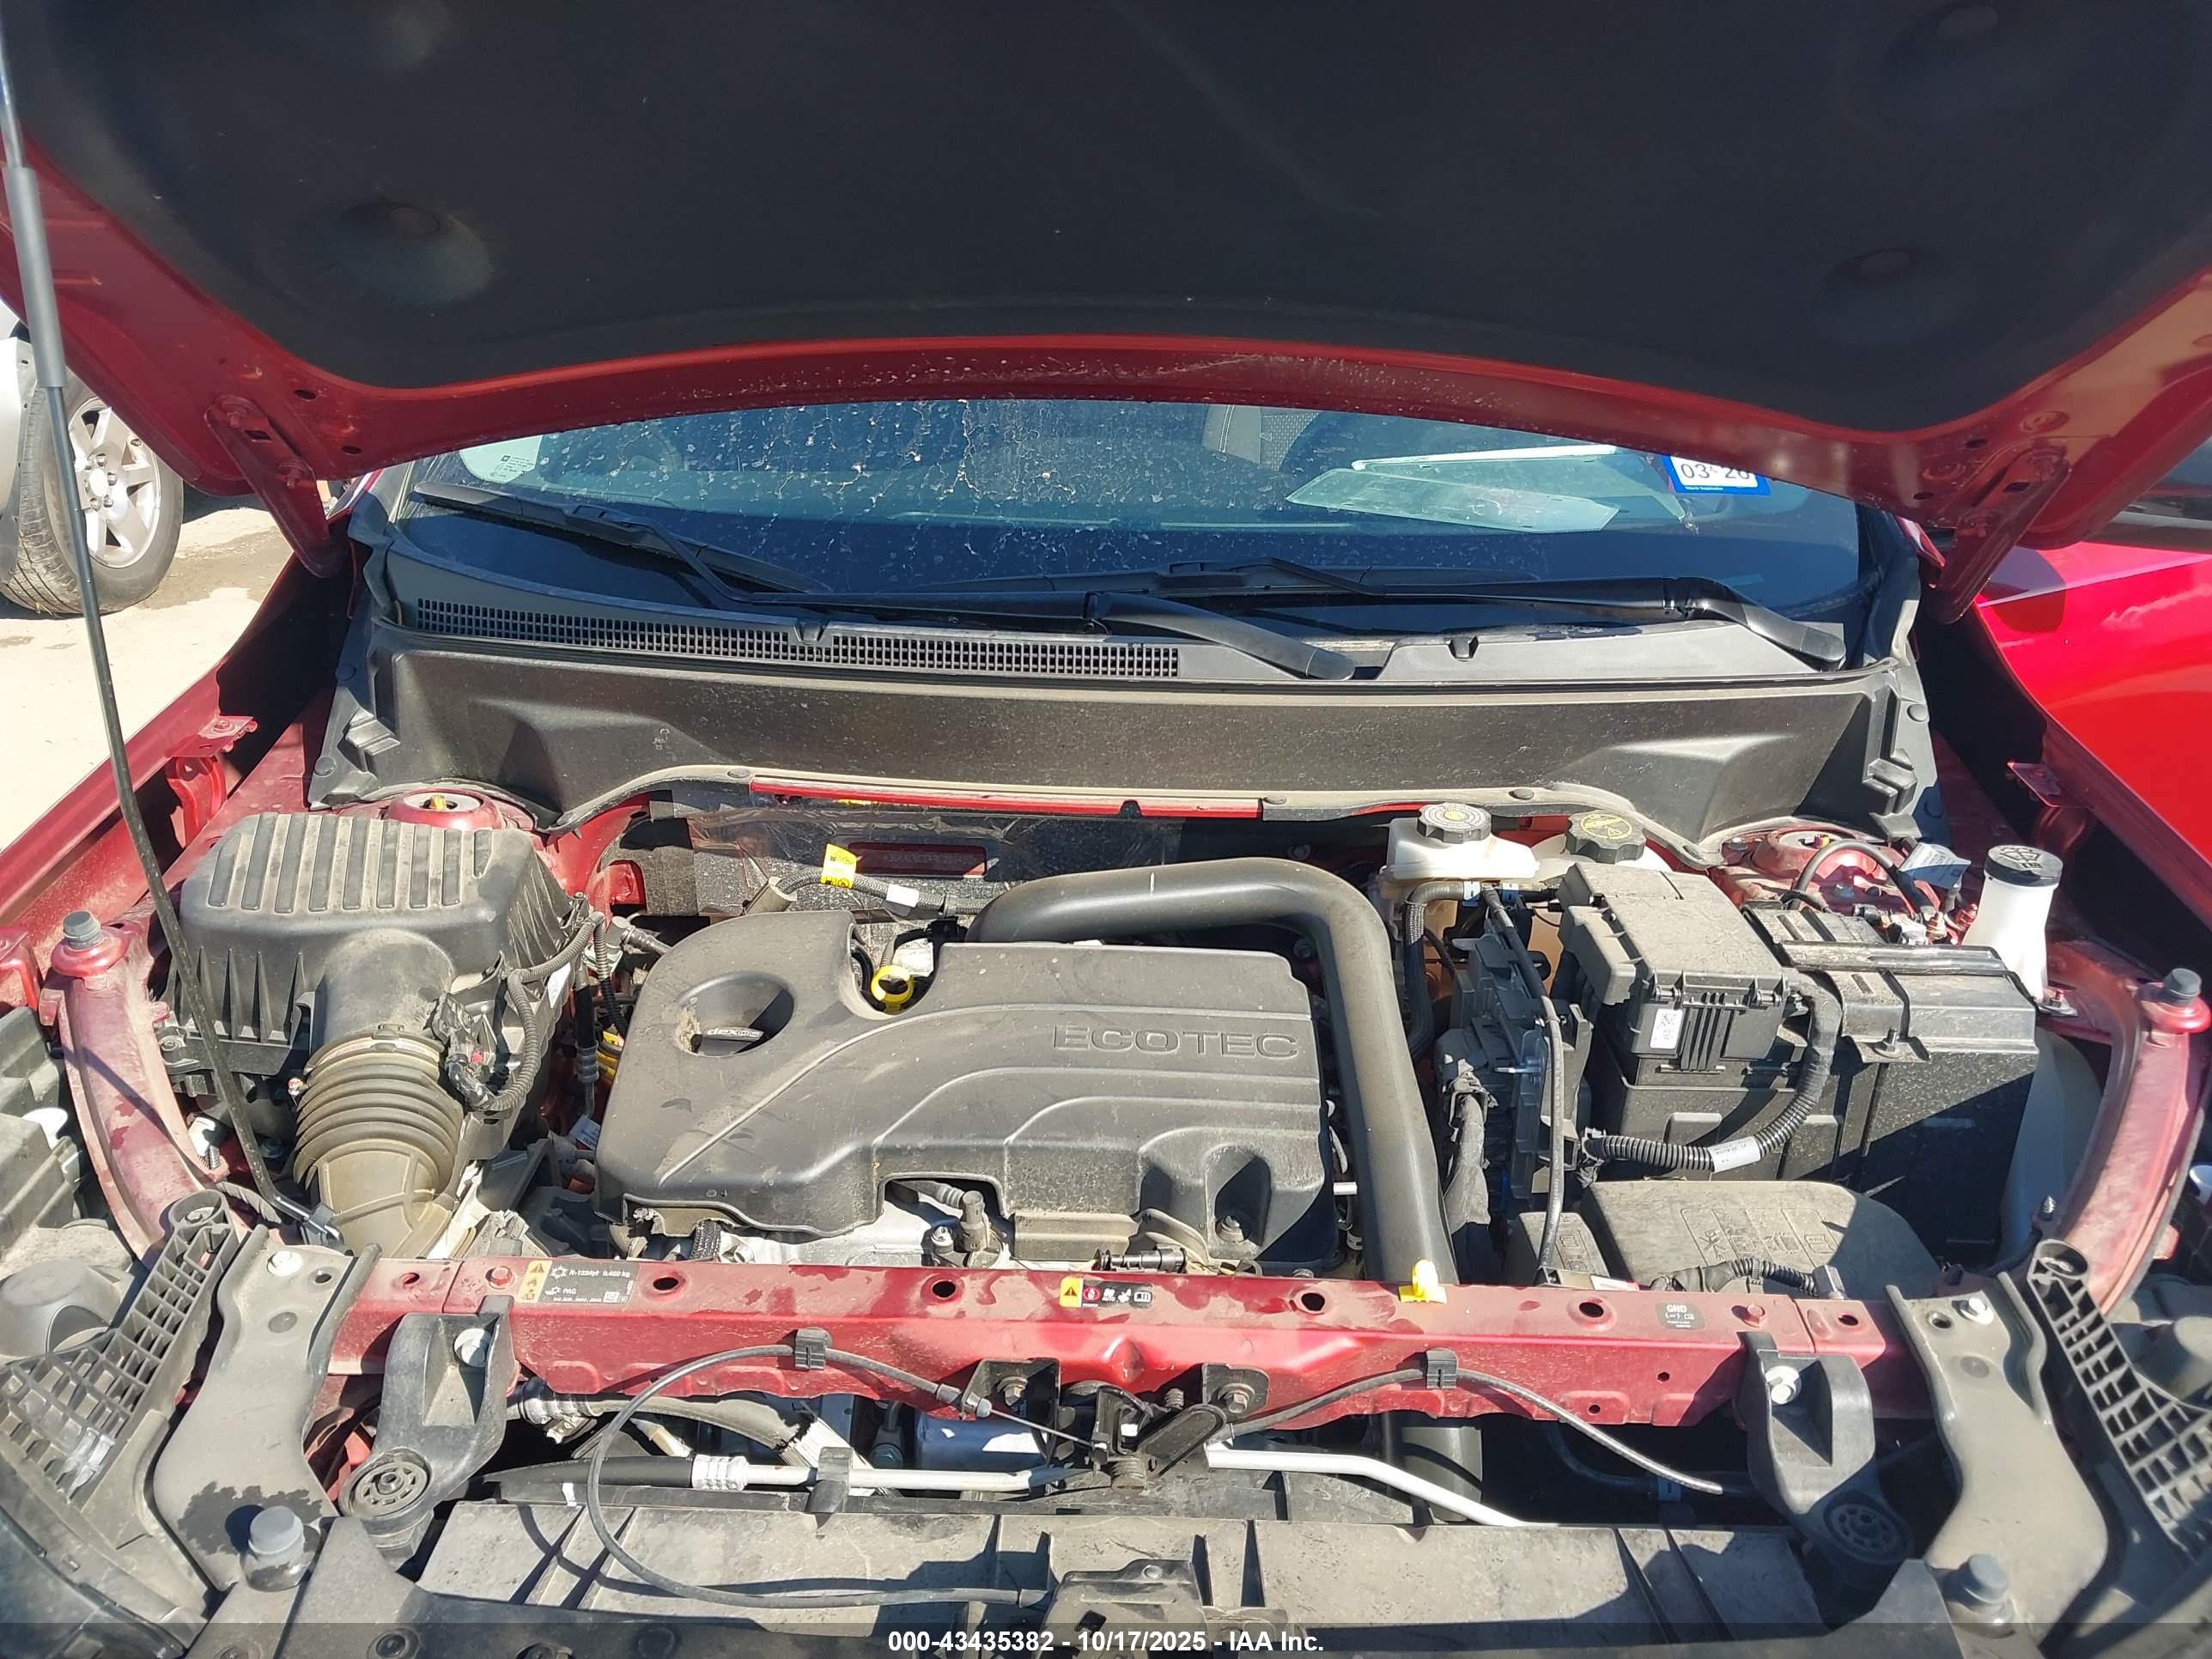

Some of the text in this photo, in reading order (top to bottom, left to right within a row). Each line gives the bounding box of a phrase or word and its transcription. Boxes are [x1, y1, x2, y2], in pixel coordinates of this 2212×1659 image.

[1680, 463, 1711, 479] 03
[706, 1027, 764, 1037] dexos
[1053, 1024, 1299, 1060] ECOTEC
[568, 1269, 600, 1278] R-1234yf
[622, 1269, 631, 1278] kg
[1666, 1304, 1687, 1313] GND
